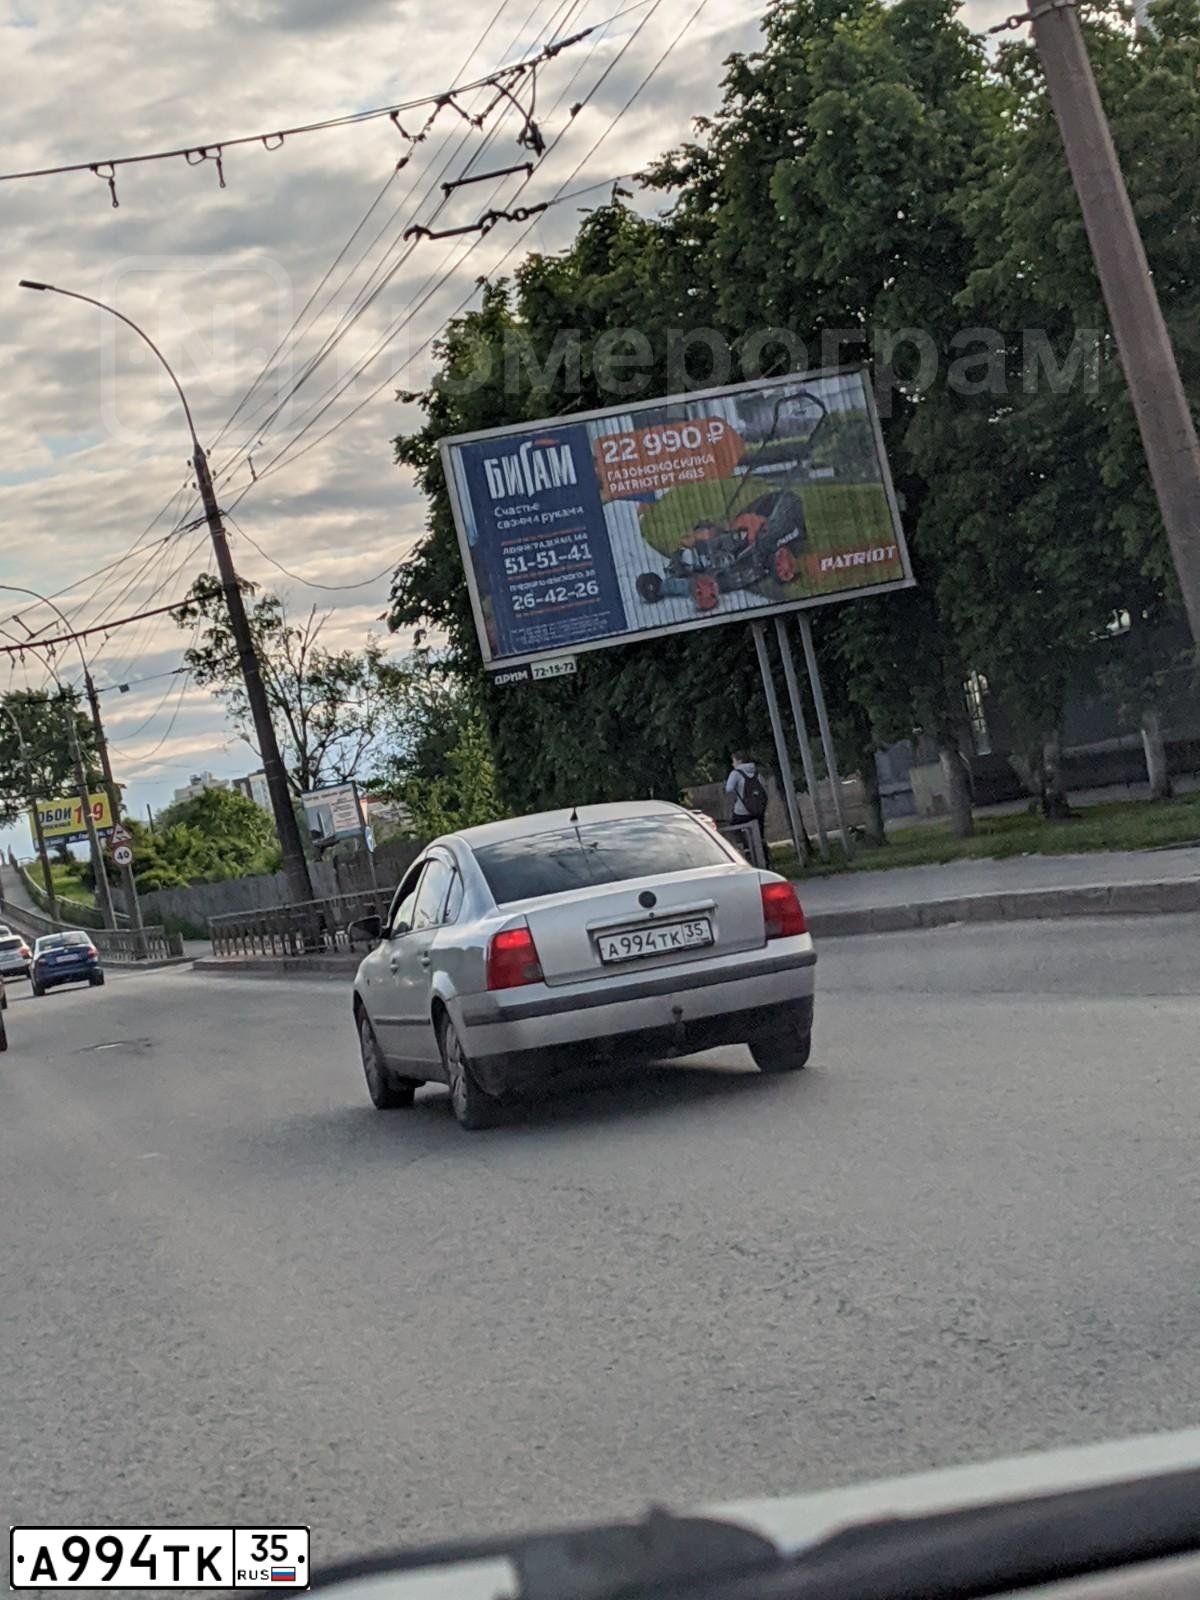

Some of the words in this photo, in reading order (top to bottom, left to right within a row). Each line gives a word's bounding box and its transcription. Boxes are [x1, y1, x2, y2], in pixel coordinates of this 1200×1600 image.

[602, 438, 639, 464] 22
[642, 426, 702, 456] 990
[609, 475, 660, 494] PATRIOT
[660, 472, 675, 484] PT
[504, 542, 592, 575] 51-51-41
[820, 545, 897, 571] PATRIOT
[511, 580, 599, 611] 26-42-26
[117, 850, 130, 860] 40
[608, 931, 682, 957] А994ТК
[684, 923, 704, 938] 35
